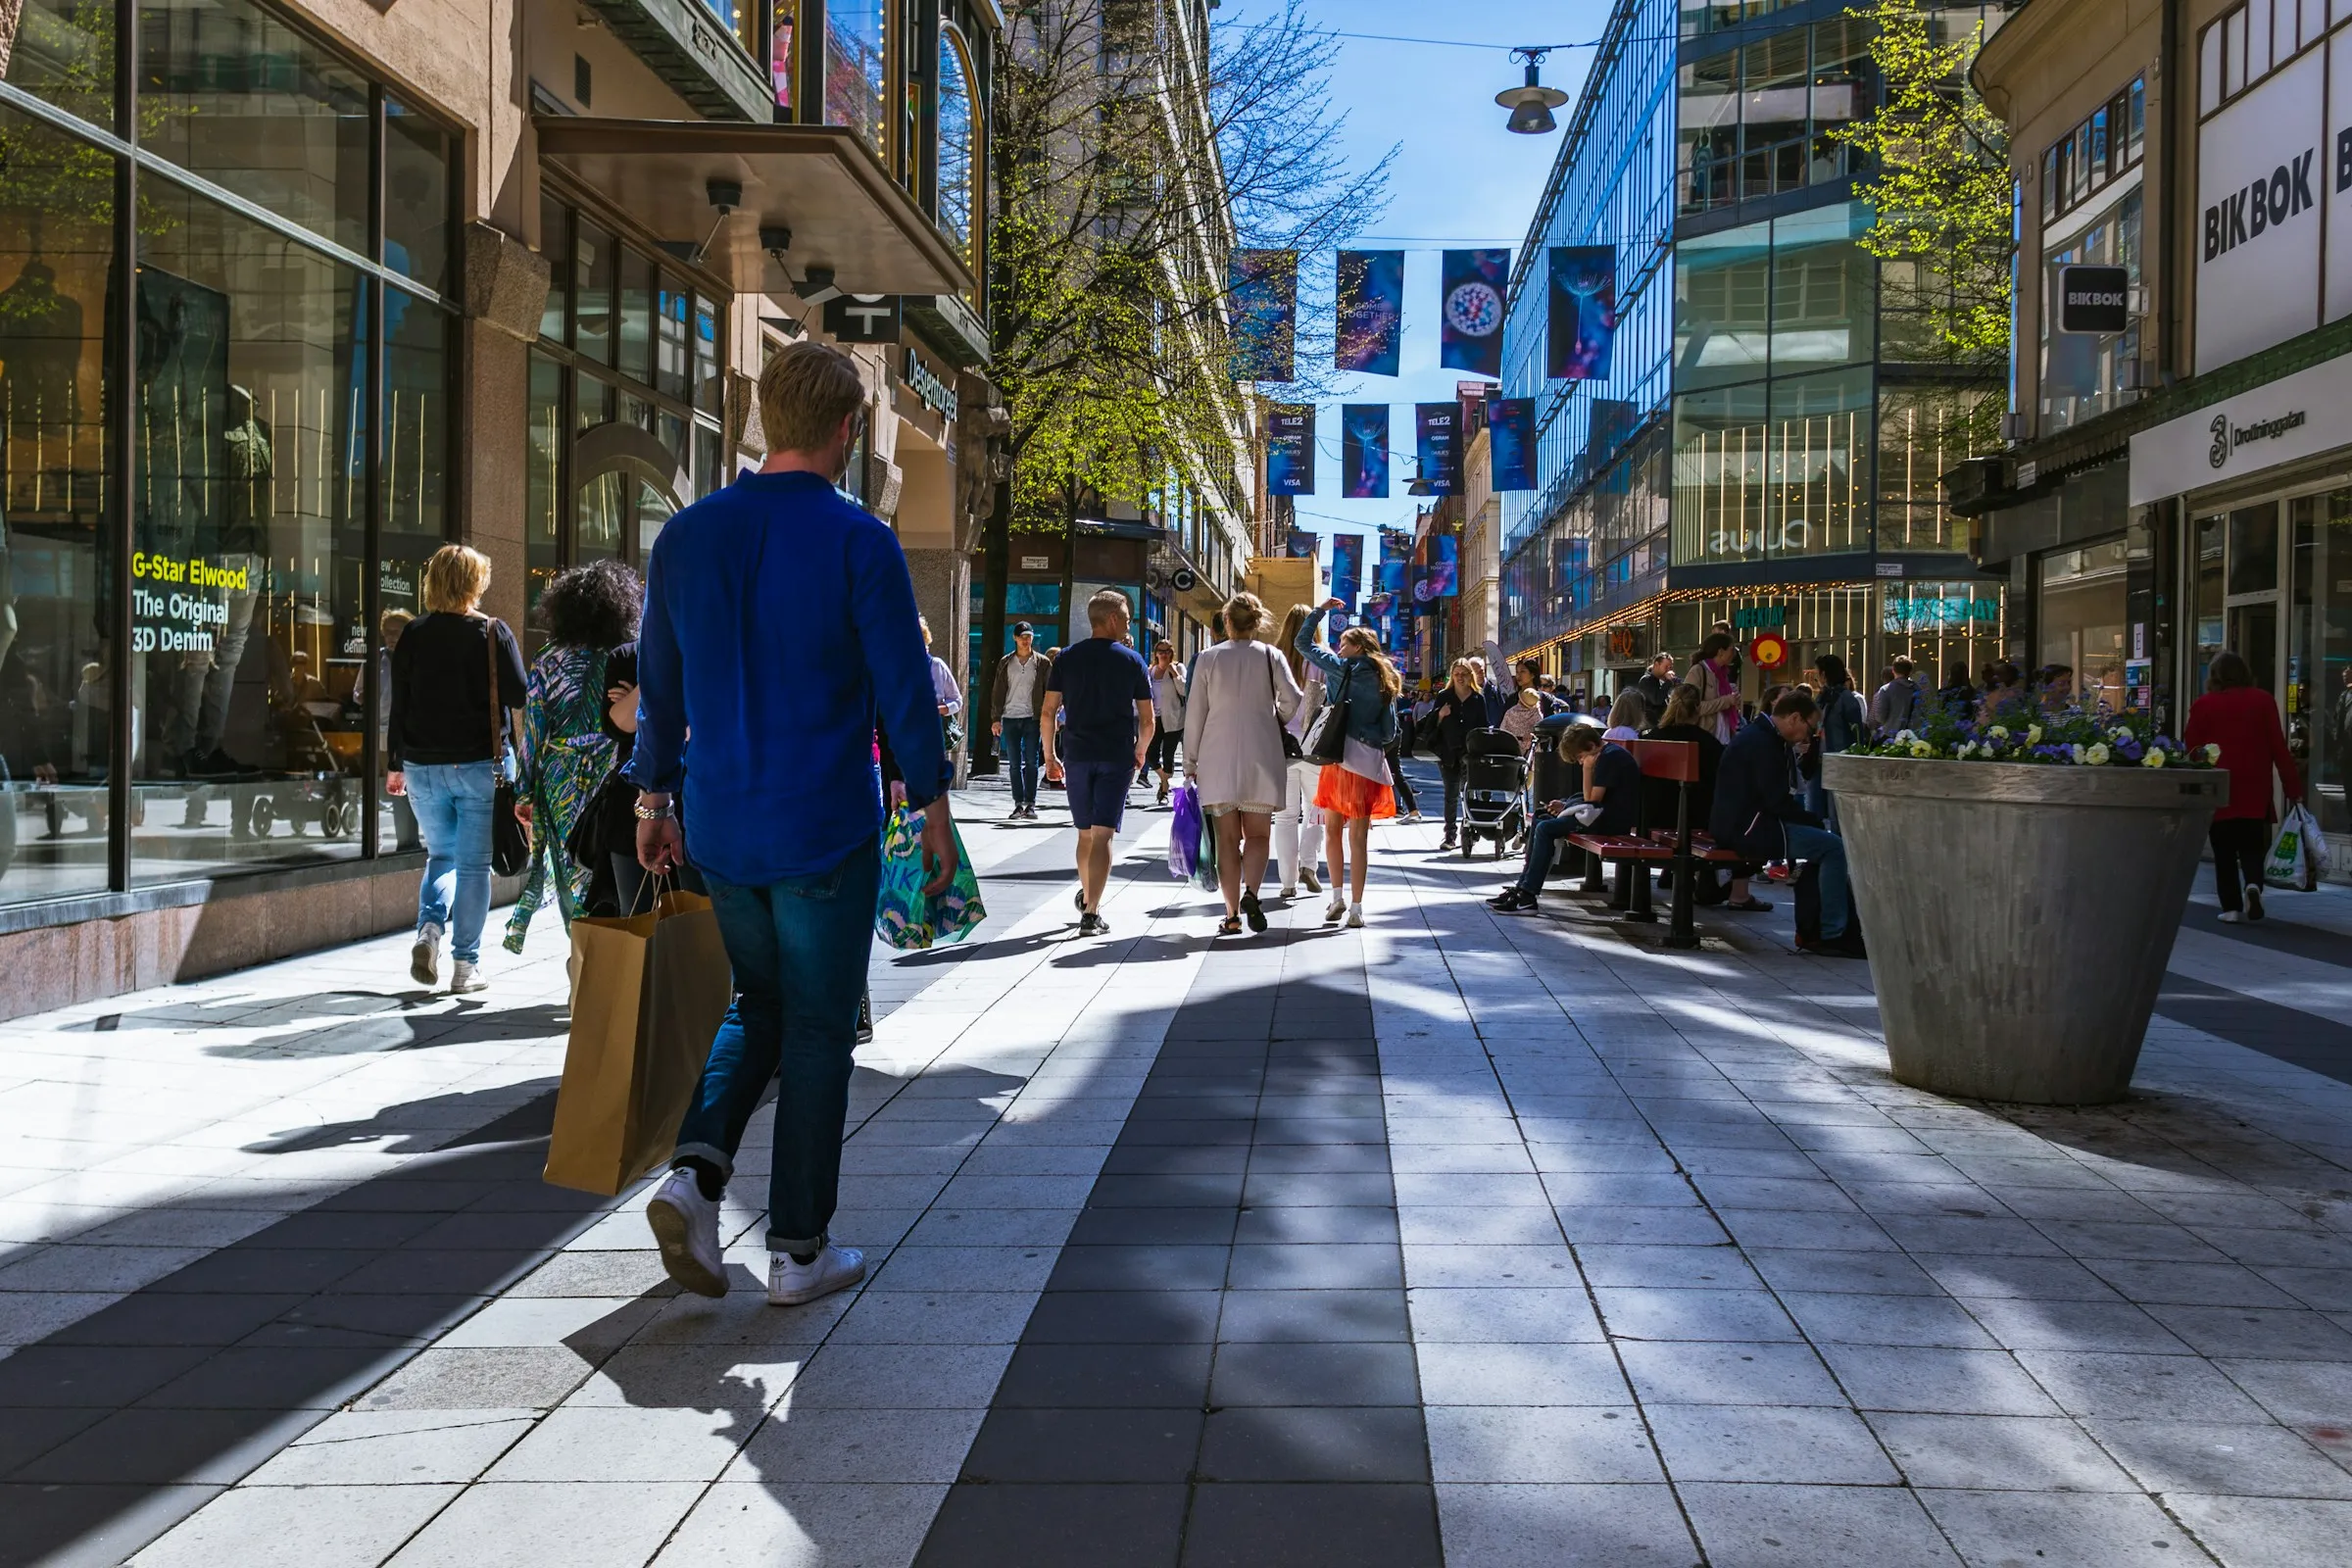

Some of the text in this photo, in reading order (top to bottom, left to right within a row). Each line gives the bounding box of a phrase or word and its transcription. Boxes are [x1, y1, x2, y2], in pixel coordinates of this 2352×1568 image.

[1281, 416, 1302, 425] TELE2
[1428, 416, 1450, 425] TELE2
[132, 552, 247, 590] G-Star Elwood
[380, 561, 392, 572] ew
[380, 575, 411, 592] ollection
[133, 589, 229, 626] The Original
[132, 626, 214, 653] 3D Denim
